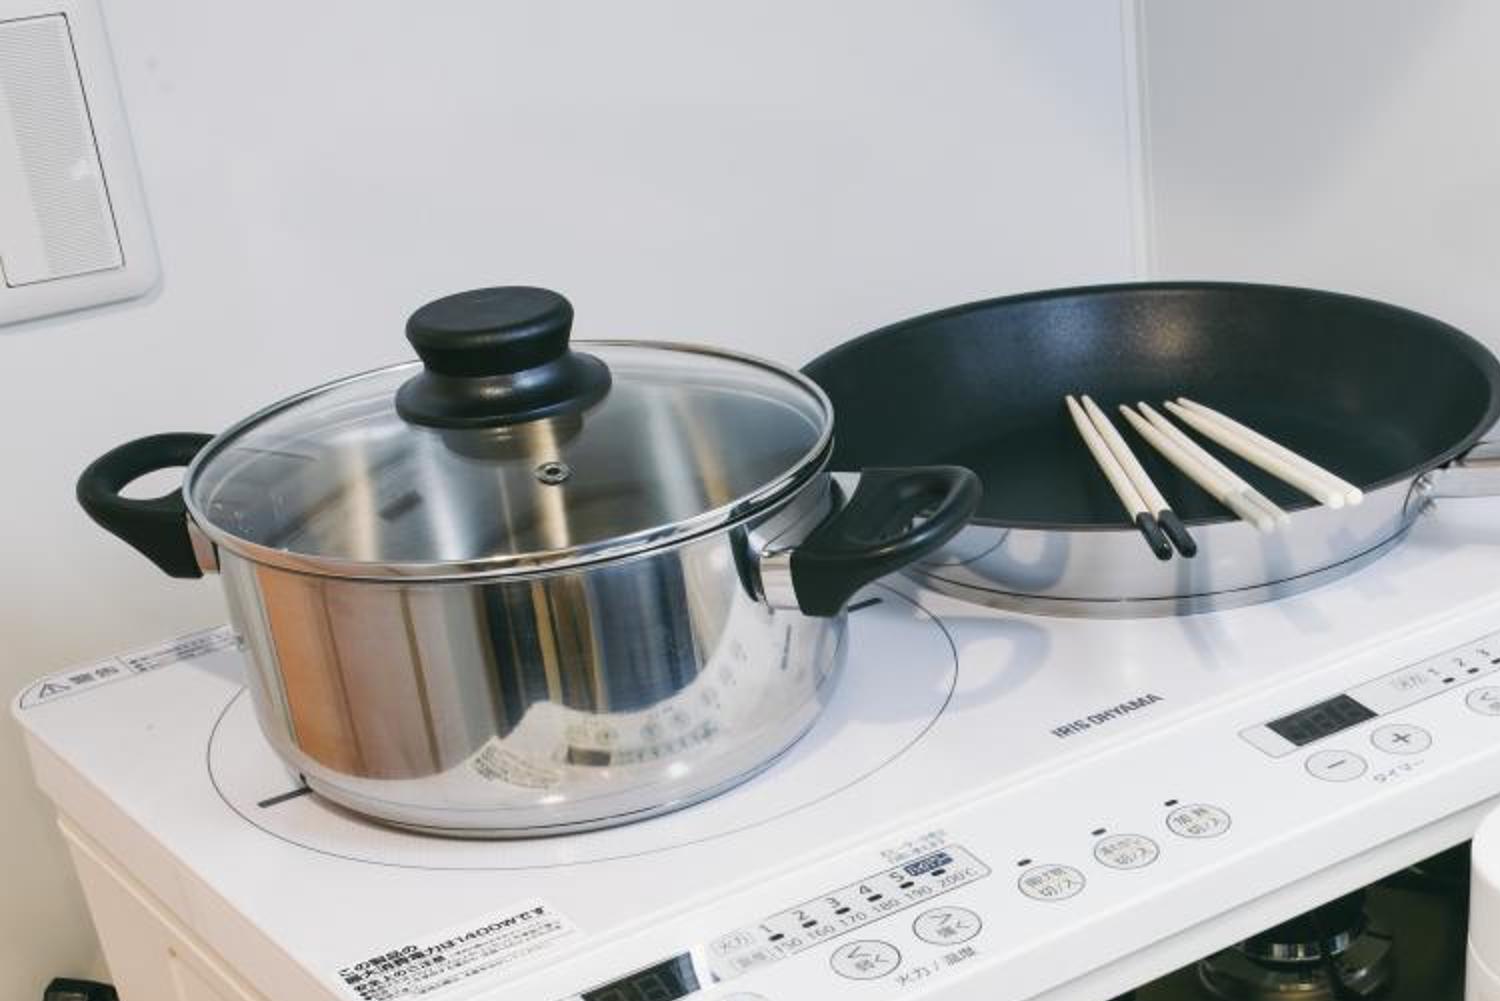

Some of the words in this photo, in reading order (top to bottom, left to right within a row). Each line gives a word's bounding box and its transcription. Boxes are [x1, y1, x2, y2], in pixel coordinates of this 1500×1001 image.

[1050, 719, 1091, 738] IRIS
[1088, 693, 1165, 727] OHYAMA
[792, 910, 809, 921] 2
[826, 897, 841, 909] 3
[859, 885, 873, 895] 4
[807, 925, 837, 940] 160
[838, 912, 868, 927] 170
[872, 898, 901, 913] 180
